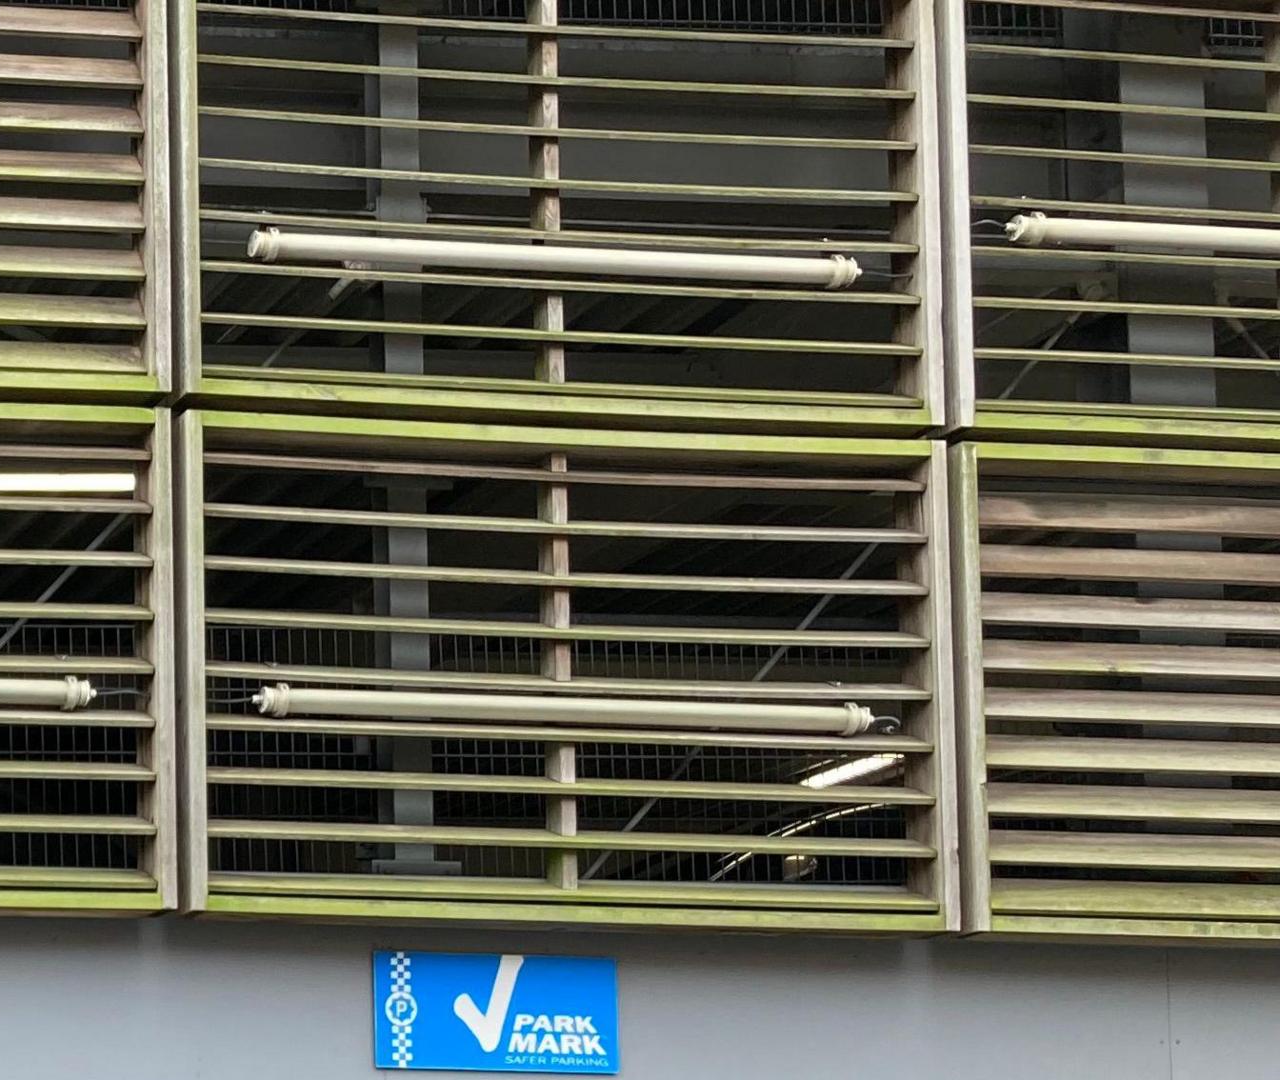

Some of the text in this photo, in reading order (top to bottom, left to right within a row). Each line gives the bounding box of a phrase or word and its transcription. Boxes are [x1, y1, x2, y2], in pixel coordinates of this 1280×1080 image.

[512, 1013, 598, 1035] PARK
[507, 1032, 608, 1056] MARK
[504, 1055, 610, 1068] SAFER PARKING
